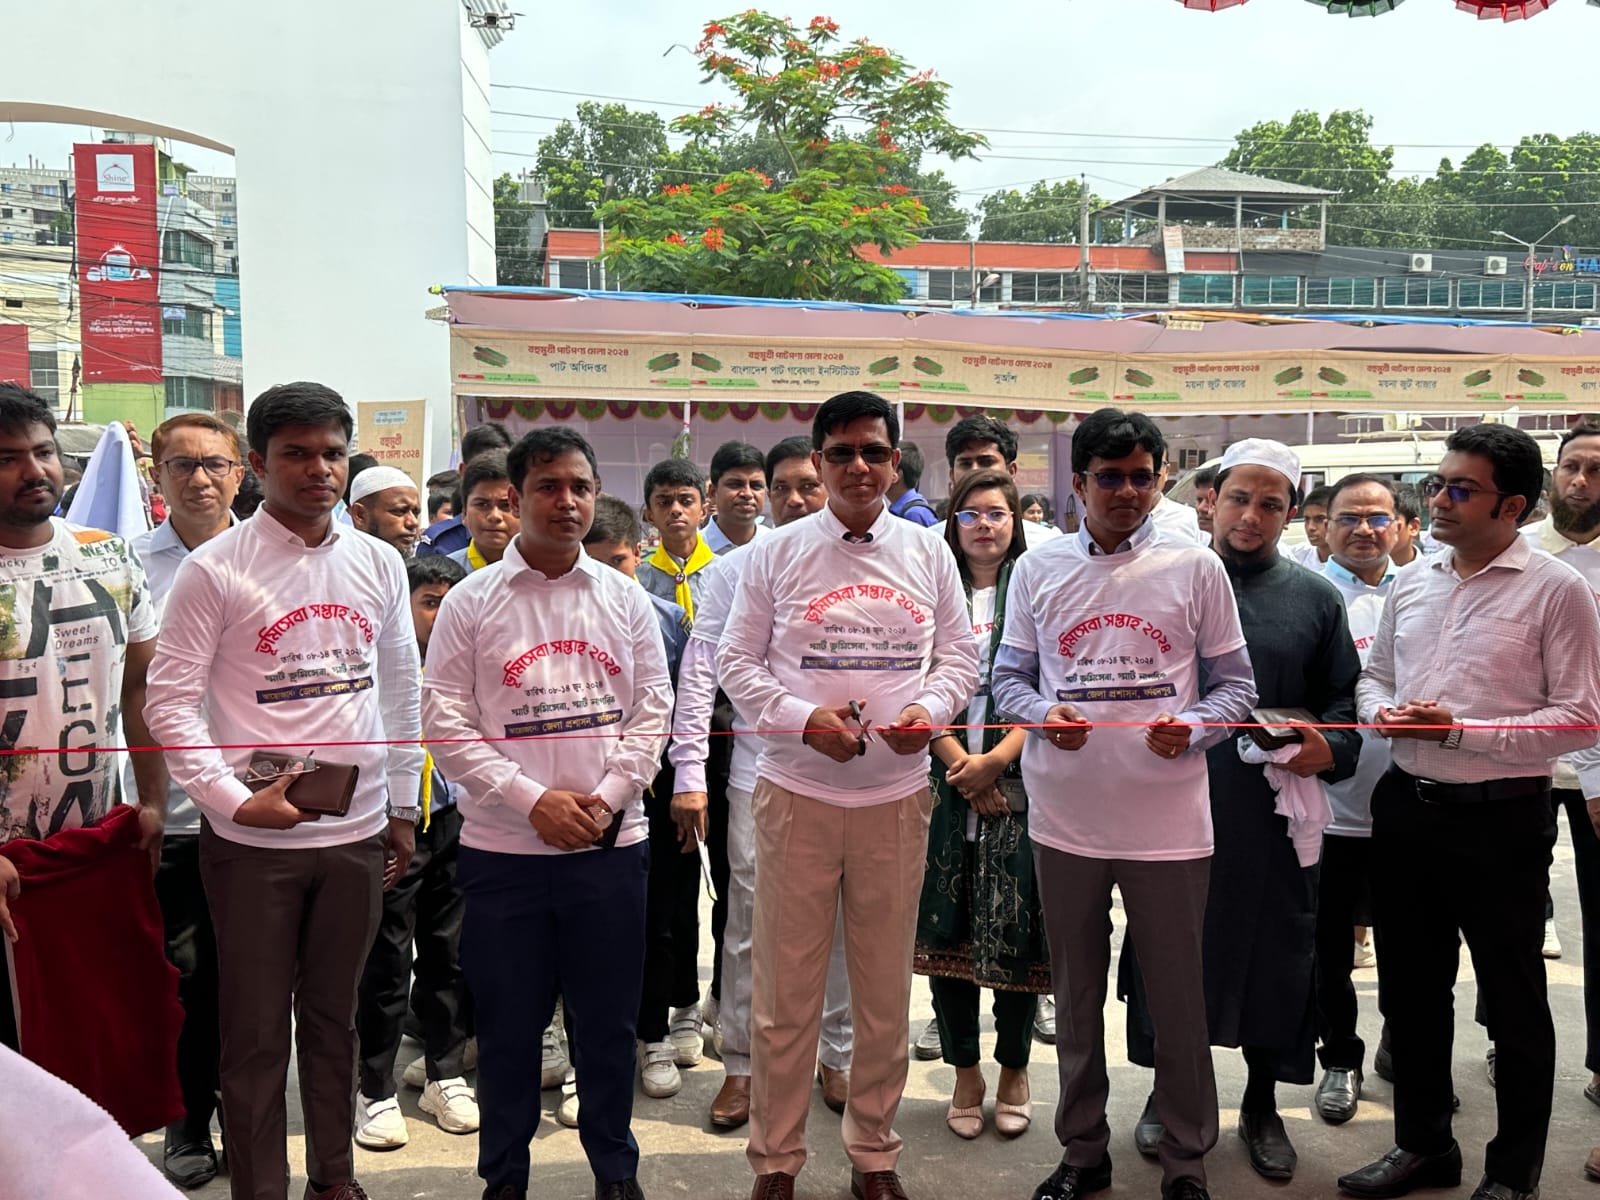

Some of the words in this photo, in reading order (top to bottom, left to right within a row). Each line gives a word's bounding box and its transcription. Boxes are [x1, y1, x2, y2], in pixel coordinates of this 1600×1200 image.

[1560, 262, 1574, 271] on
[550, 361, 566, 372] পাট
[570, 361, 607, 373] অধিদপ্তর
[731, 365, 767, 375] বাংলাদেশ
[770, 364, 784, 374] পাট
[787, 365, 816, 376] গবেষণা
[818, 364, 861, 376] ইনস্টিটিউট
[804, 586, 855, 624] ভূমিসেবা
[856, 584, 898, 602] সপ্তাহ
[896, 592, 926, 625] ২০২৪
[54, 624, 91, 638] Sweet
[255, 607, 308, 656] ভূমিসেবা
[309, 604, 350, 622] সপ্তাহ
[1058, 617, 1102, 658] ভূমিসেবা
[1103, 613, 1144, 631] সপ্তাহ
[1142, 622, 1172, 654] ২০২৪
[56, 635, 99, 650] Dreams
[502, 643, 550, 688] ভূমিসেবা
[550, 640, 590, 656] সপ্তাহ
[589, 645, 622, 676] ২০২৪
